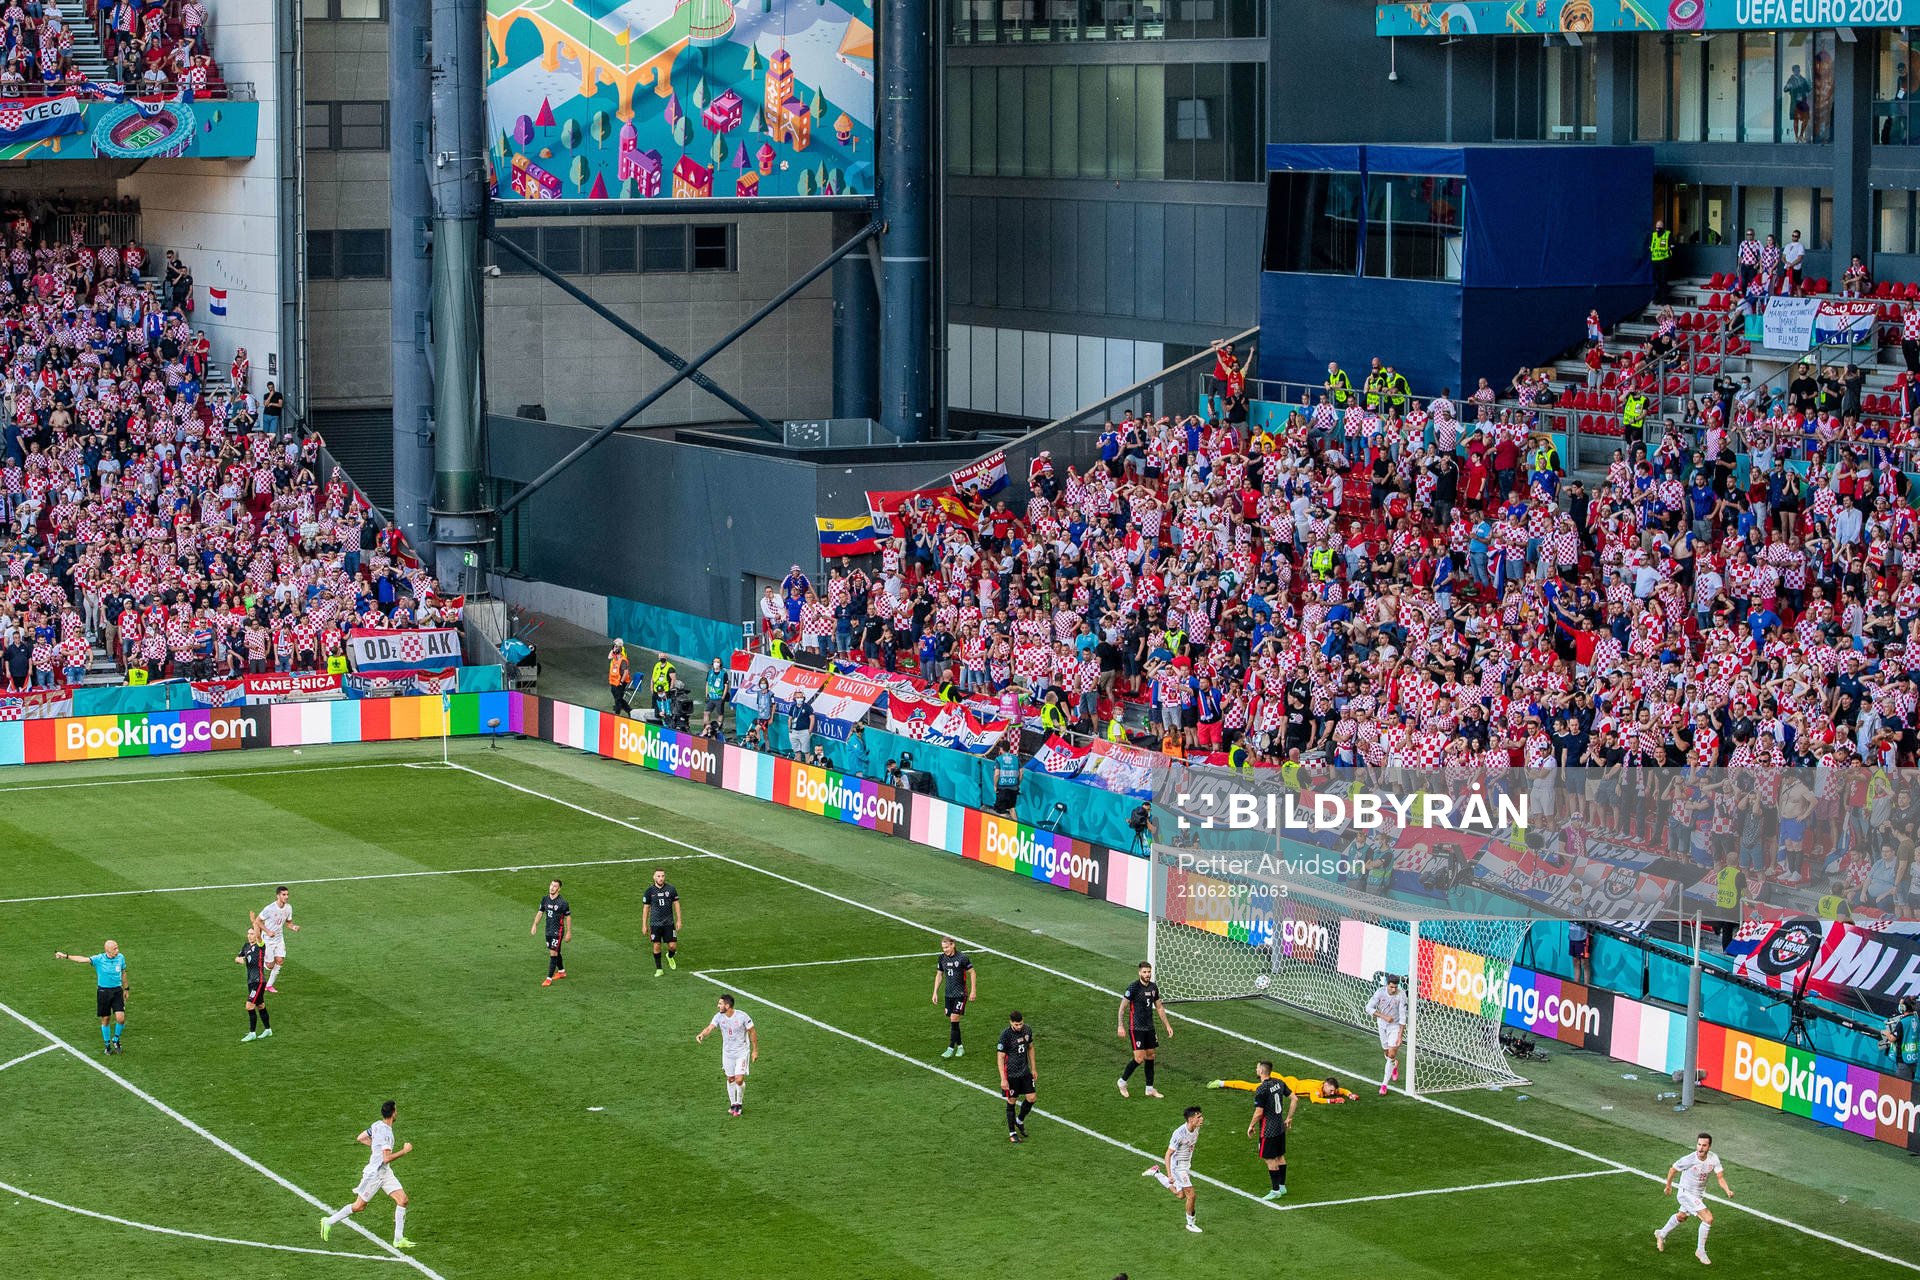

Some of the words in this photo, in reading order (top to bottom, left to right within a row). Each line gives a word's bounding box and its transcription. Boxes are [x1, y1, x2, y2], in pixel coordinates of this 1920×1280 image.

[1736, 0, 1787, 25] UEFA
[1791, 0, 1846, 24] EURO
[1850, 0, 1903, 22] 2020
[25, 102, 62, 121] VEC
[250, 675, 336, 692] KAMEŠNICA
[67, 718, 257, 749] Booking.com
[619, 723, 716, 774] Booking.com
[817, 719, 843, 739] KÖLN
[796, 769, 904, 825] Booking.com
[986, 821, 1099, 885] Booking.com
[1811, 931, 1898, 990] MI
[1441, 954, 1600, 1037] Booking.com
